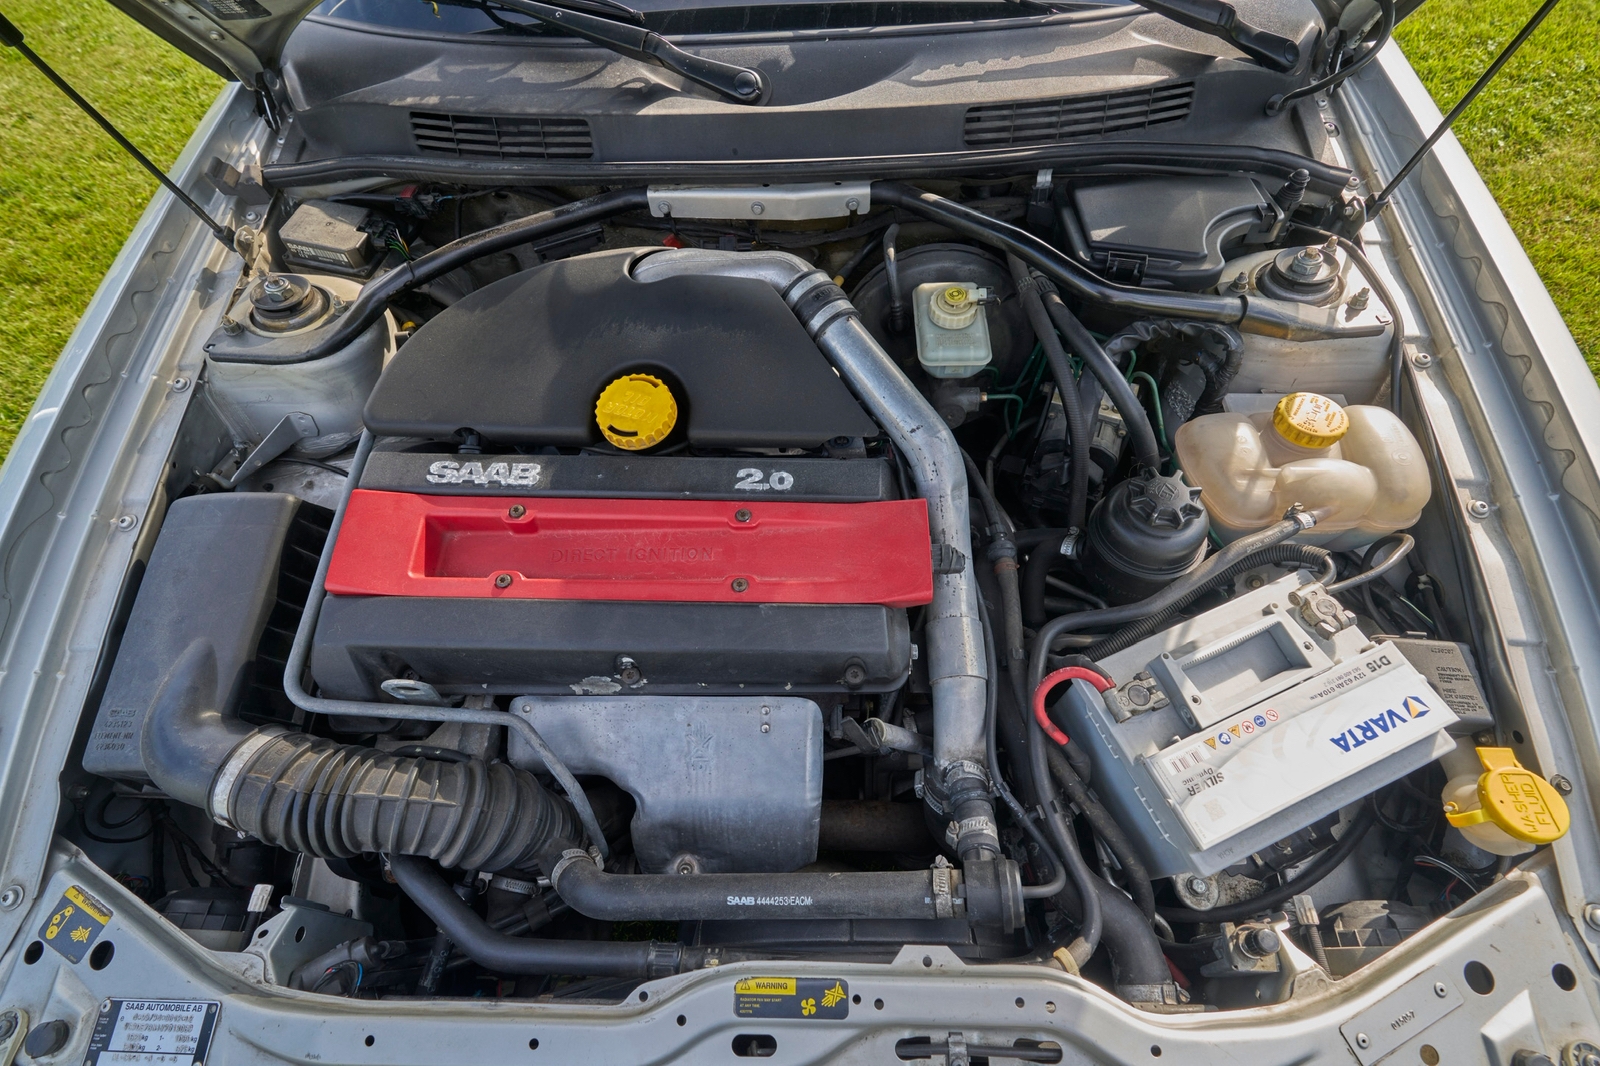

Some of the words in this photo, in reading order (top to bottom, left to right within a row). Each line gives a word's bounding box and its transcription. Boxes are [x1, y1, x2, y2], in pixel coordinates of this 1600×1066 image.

[426, 461, 541, 487] SAAB
[734, 468, 794, 491] 2.0
[550, 547, 618, 563] DIRECT
[626, 546, 715, 562] IGNITION
[1365, 655, 1391, 673] D15
[1334, 678, 1353, 689] 63Ah
[1355, 671, 1366, 681] 12V
[1330, 708, 1407, 752] VARTA
[1501, 774, 1538, 832] WASHER
[1520, 781, 1550, 824] FLUID
[727, 896, 755, 906] SAAB
[755, 982, 788, 990] WARNING
[125, 1002, 145, 1011] SAAB
[146, 1003, 191, 1012] AUTOMOBILE
